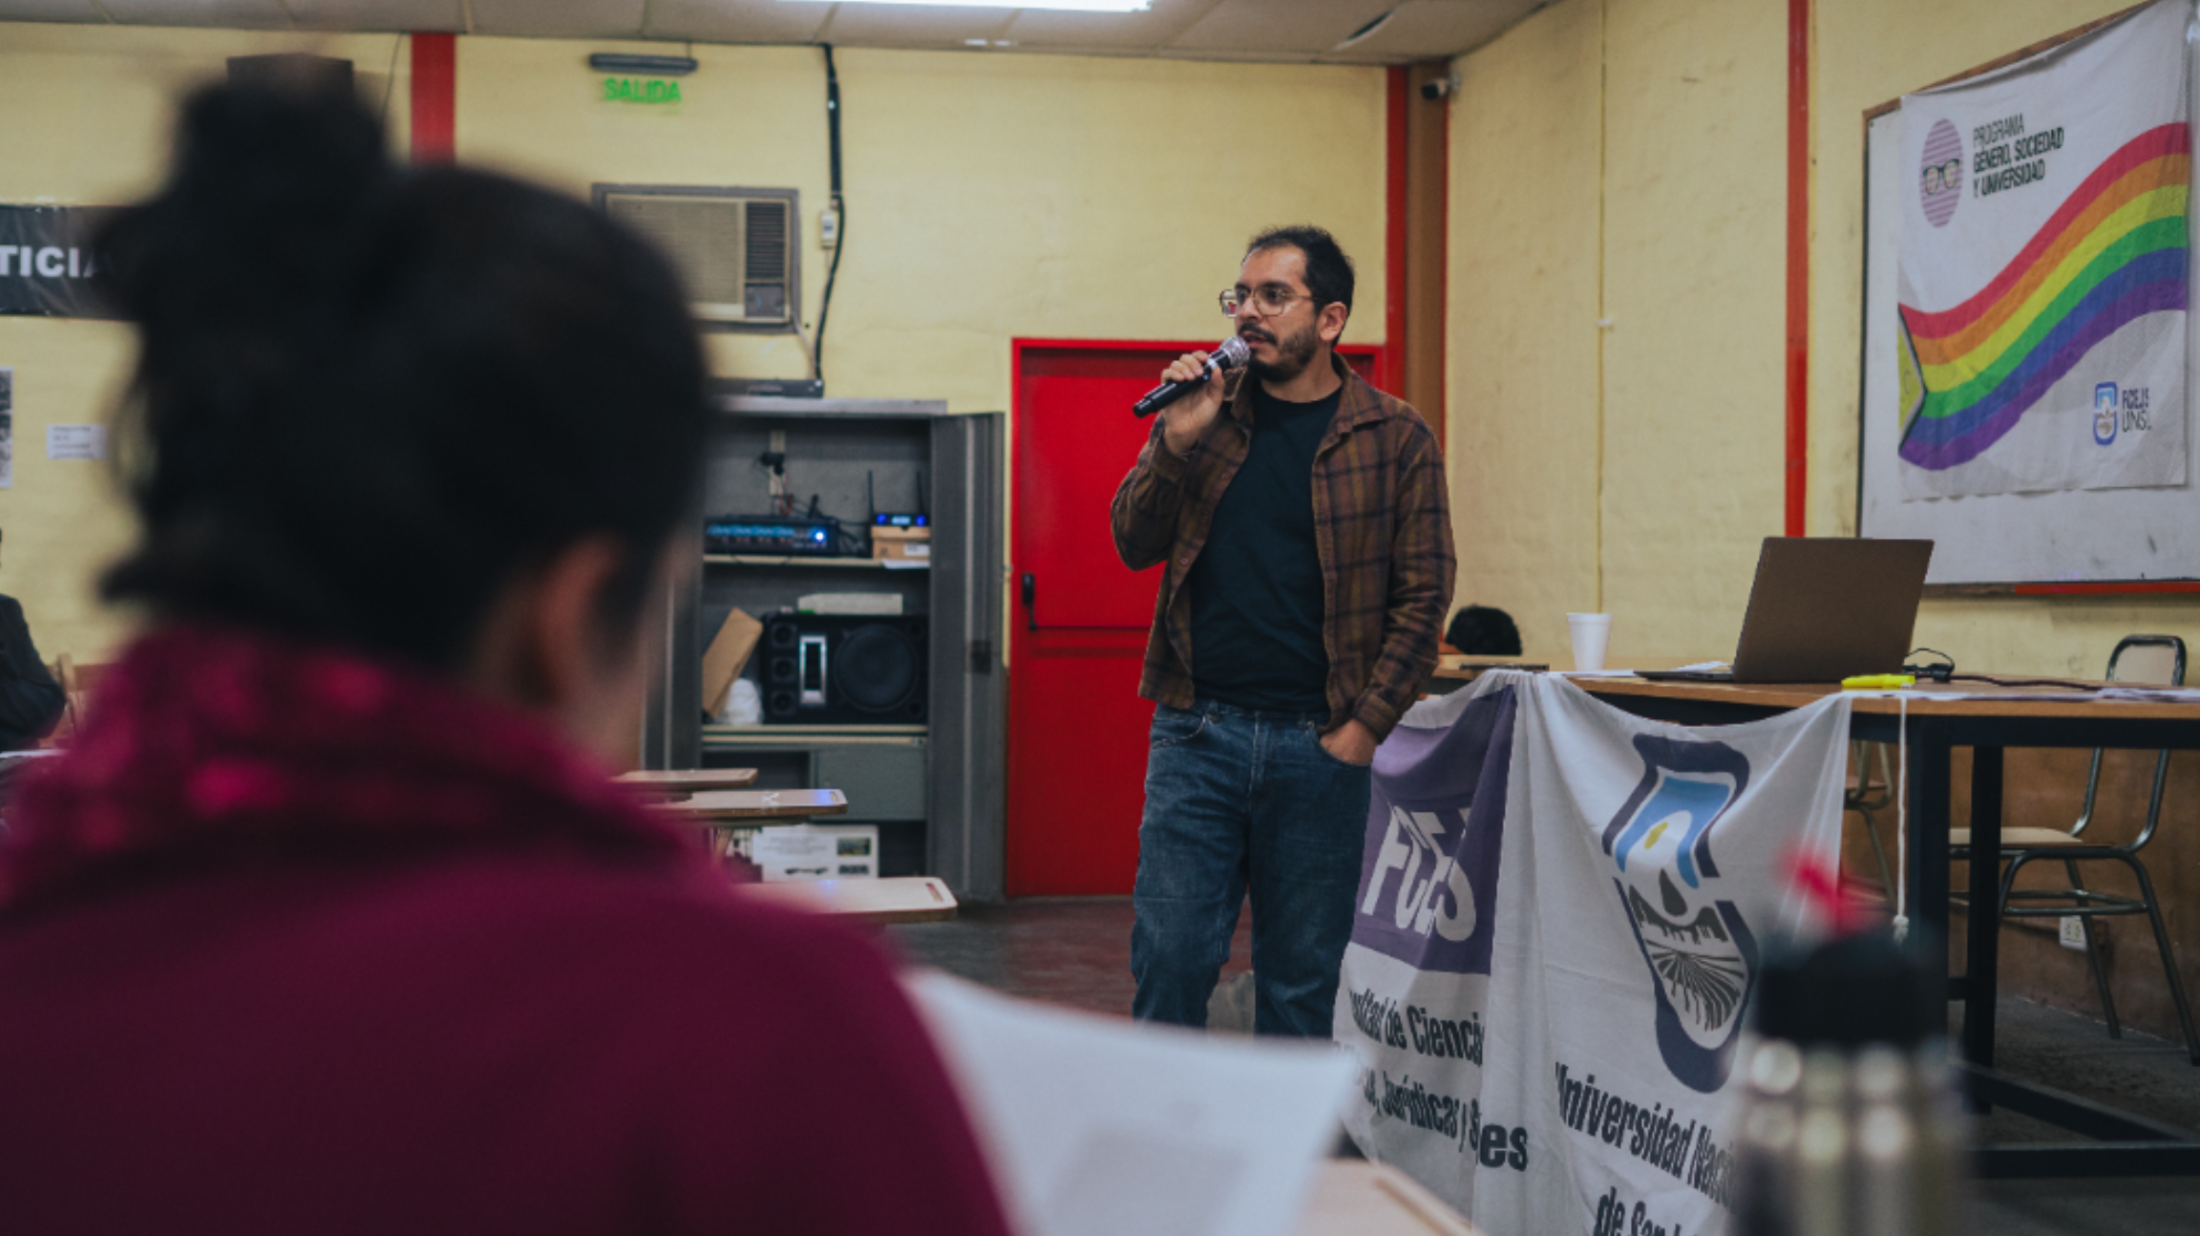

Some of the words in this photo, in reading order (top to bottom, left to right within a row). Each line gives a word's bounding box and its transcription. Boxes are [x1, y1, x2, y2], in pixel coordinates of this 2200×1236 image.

[604, 77, 682, 104] SALIDA
[1973, 113, 2024, 148] PROGRAMA
[2014, 126, 2064, 161] SOCIEDAD
[1973, 177, 1980, 198] Y
[1981, 158, 2046, 196] UNIVERSIDAD
